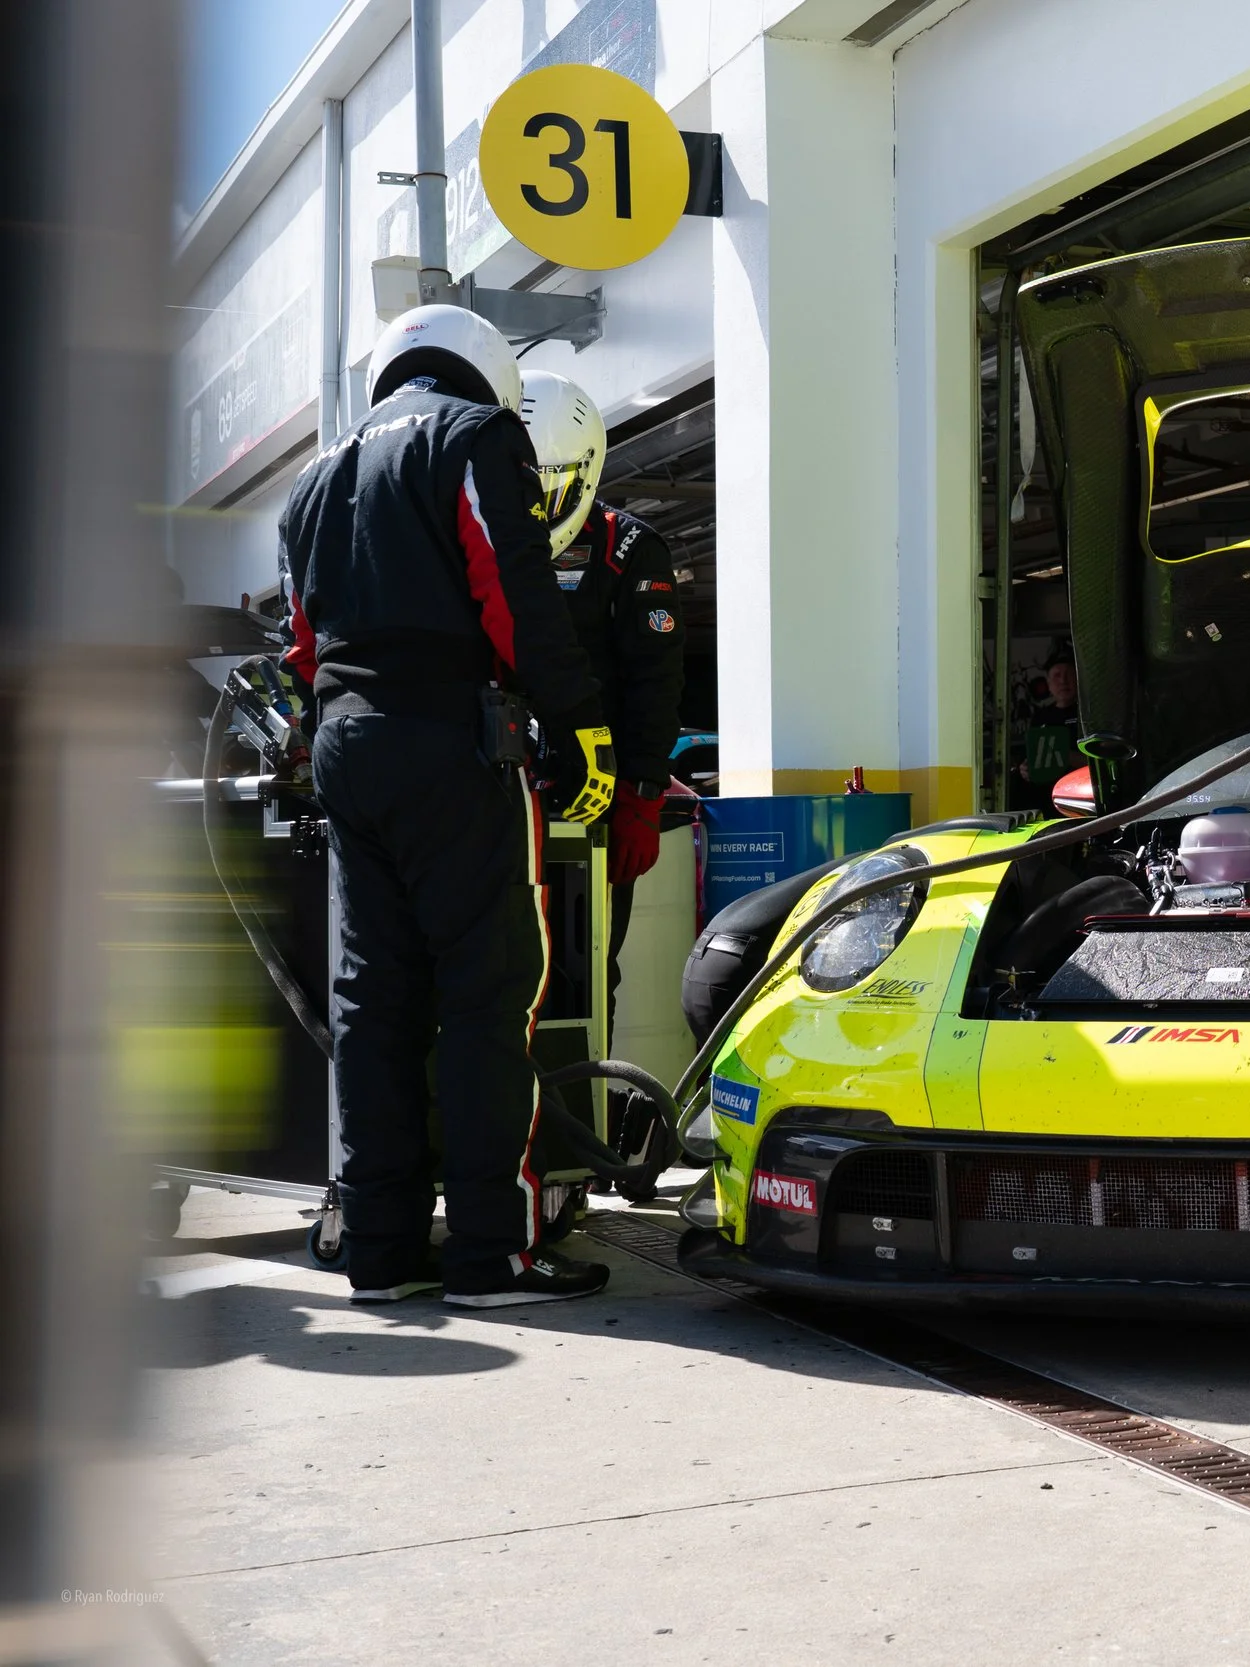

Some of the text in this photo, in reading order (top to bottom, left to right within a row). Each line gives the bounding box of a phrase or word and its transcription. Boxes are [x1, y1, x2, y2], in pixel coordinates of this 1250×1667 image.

[520, 112, 632, 220] 31
[445, 157, 480, 247] 912
[405, 324, 425, 333] BELL
[218, 391, 232, 443] 69
[315, 412, 437, 464] MANTHEY
[615, 525, 642, 560] HRX
[722, 843, 747, 853] EVERY
[862, 978, 934, 996] ENDLESS
[1148, 1028, 1240, 1044] IMSA
[713, 1088, 752, 1112] MICHELIN
[756, 1175, 813, 1209] MOTUL
